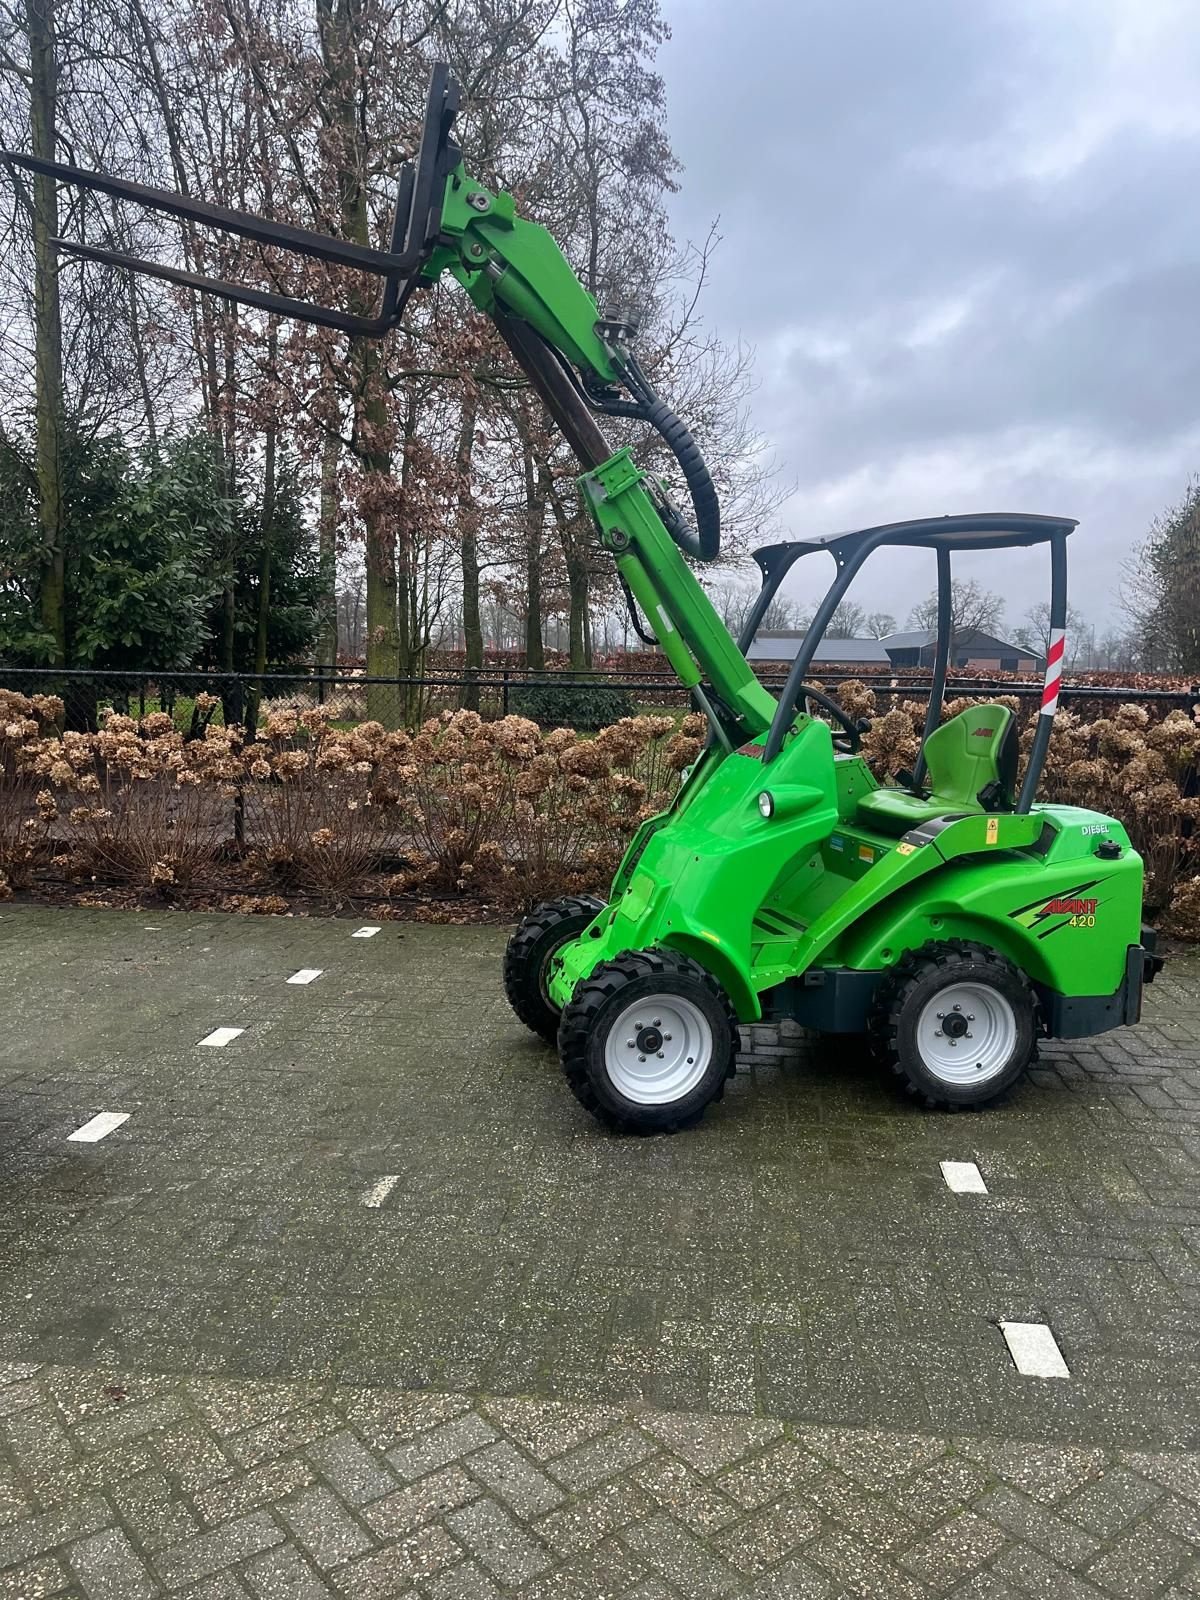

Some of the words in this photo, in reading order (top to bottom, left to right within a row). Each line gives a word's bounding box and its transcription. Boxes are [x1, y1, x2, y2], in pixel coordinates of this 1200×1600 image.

[1081, 824, 1109, 835] DIESEL
[1039, 898, 1098, 914] AVANT
[1069, 915, 1095, 927] 420
